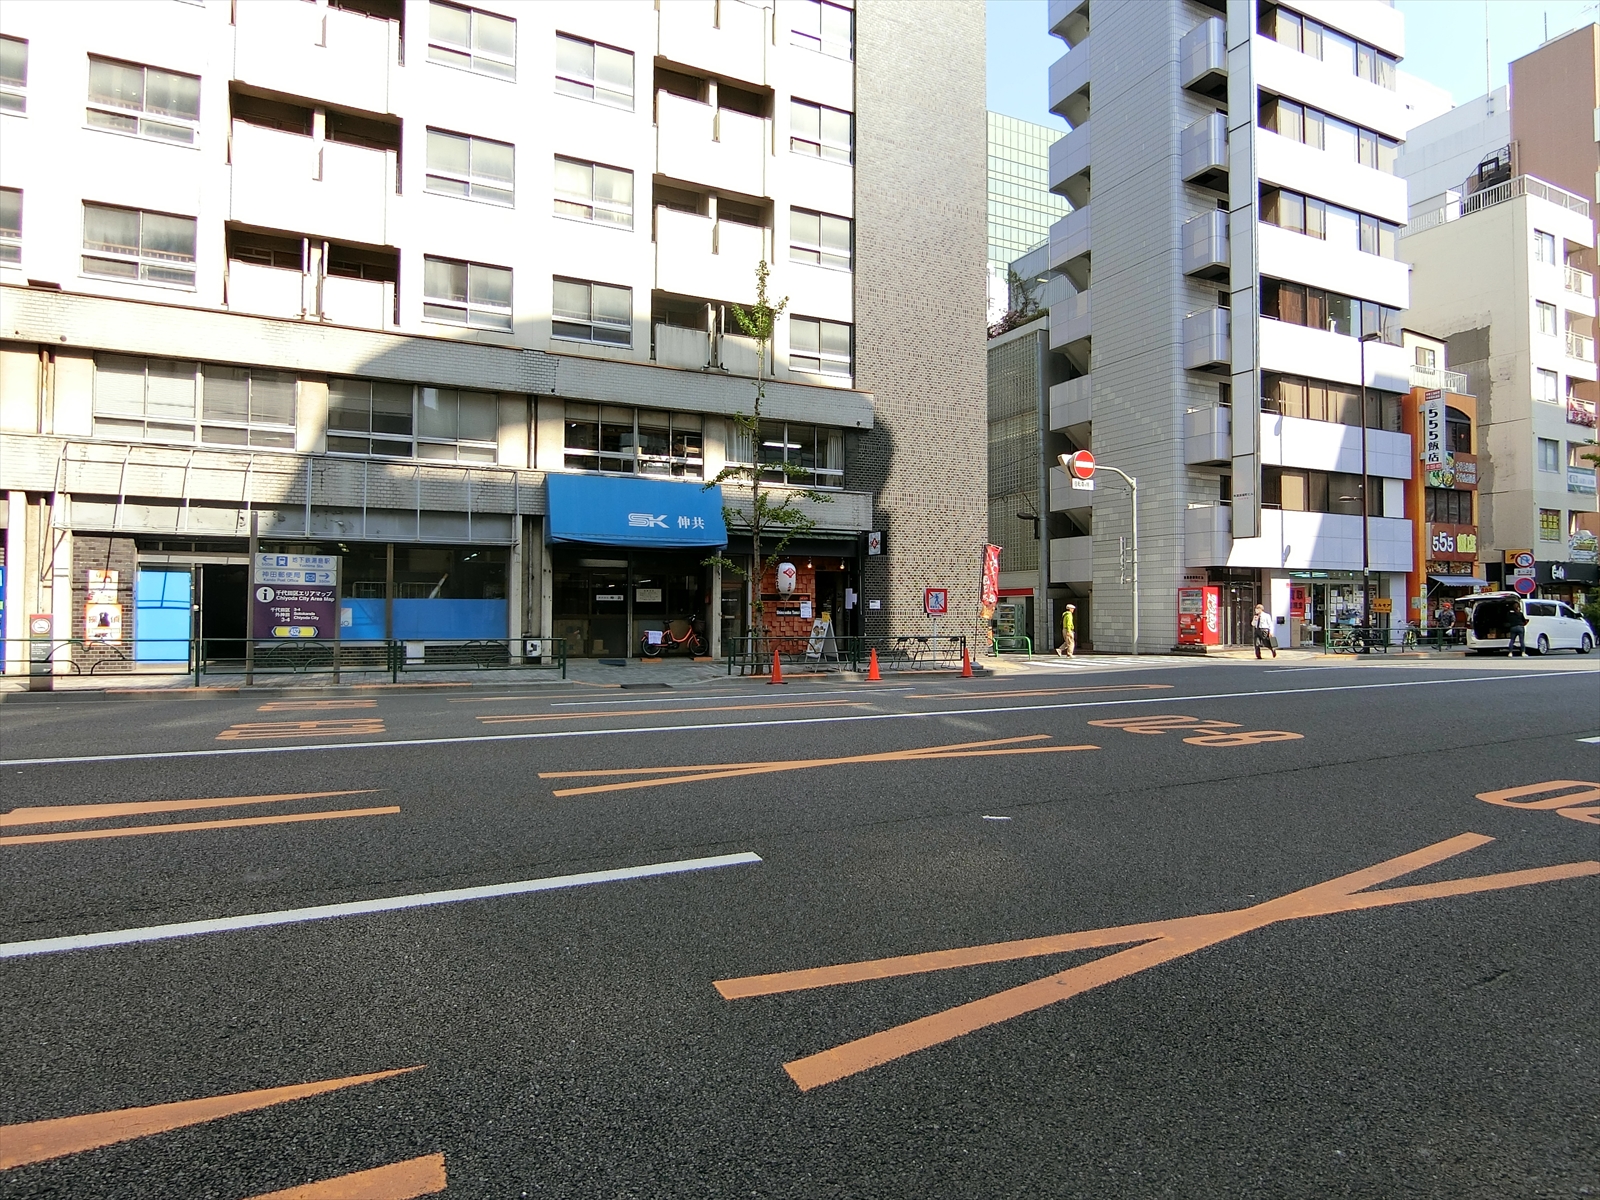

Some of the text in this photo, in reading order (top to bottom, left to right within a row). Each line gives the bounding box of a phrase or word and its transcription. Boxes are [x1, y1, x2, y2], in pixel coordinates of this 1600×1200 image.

[628, 512, 670, 529] SK
[262, 571, 301, 579] 神田郵便局
